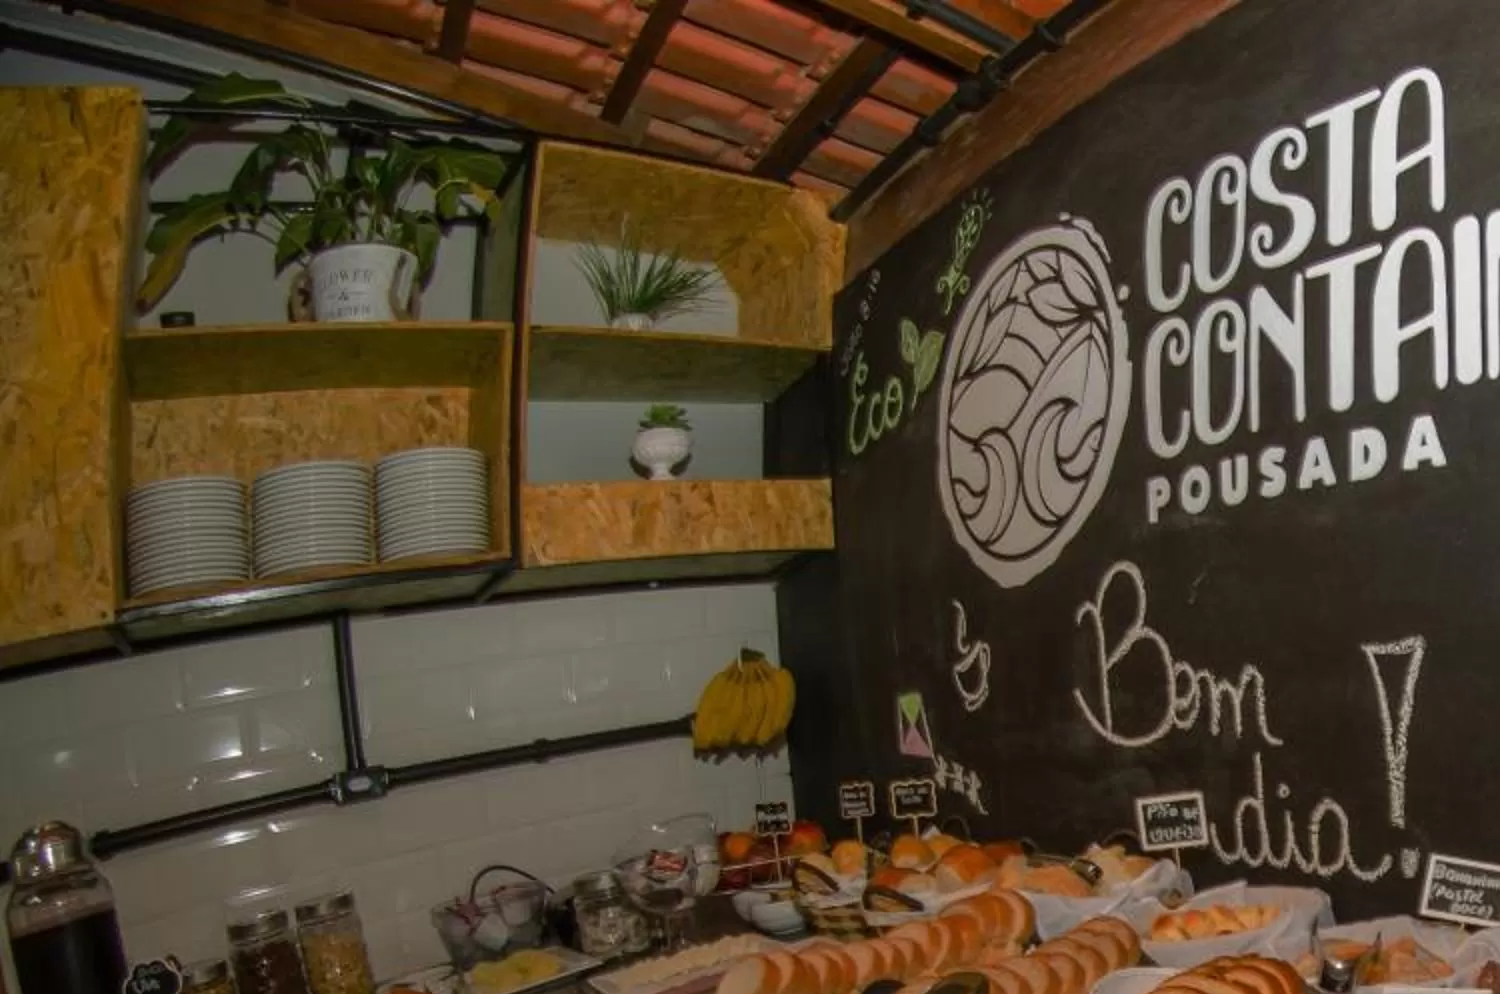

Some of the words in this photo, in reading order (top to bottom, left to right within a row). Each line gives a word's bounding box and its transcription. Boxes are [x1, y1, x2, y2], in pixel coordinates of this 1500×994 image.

[1143, 66, 1447, 313] COSTA
[1147, 415, 1447, 523] POUSADA
[1073, 560, 1284, 747] Bom
